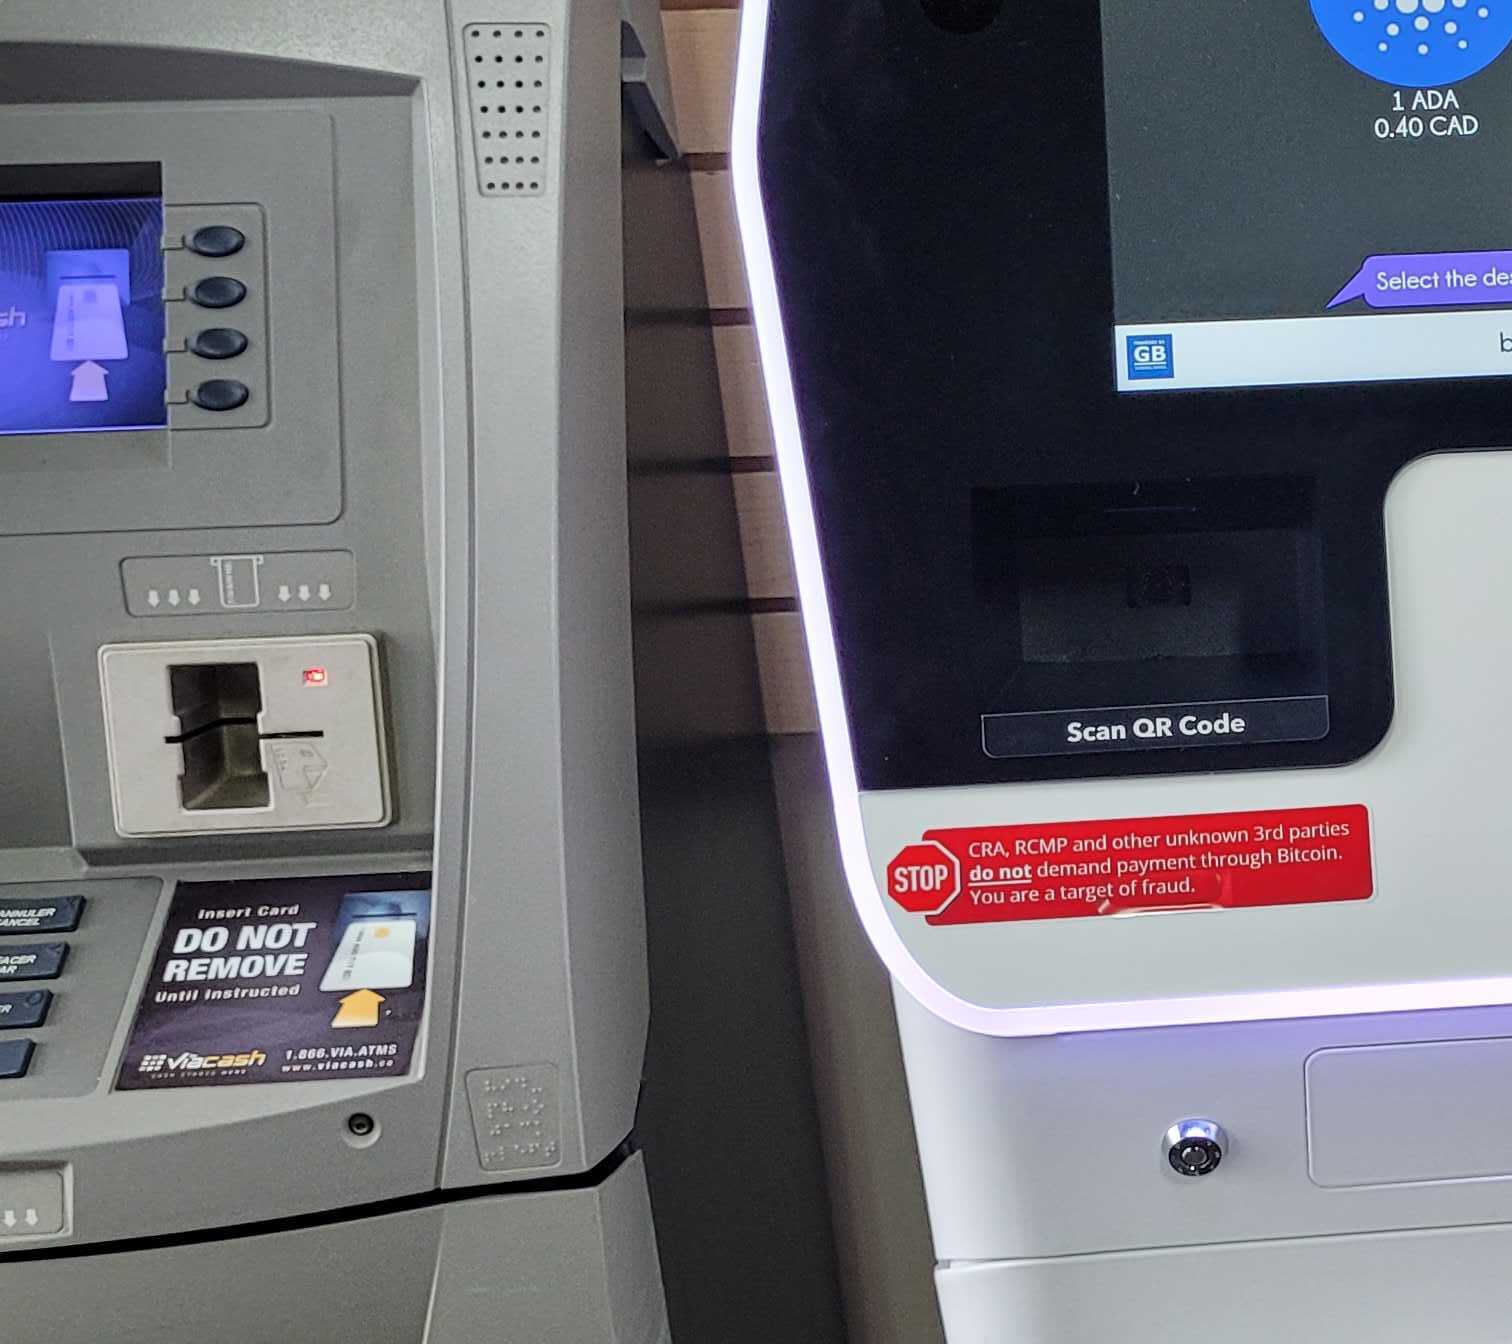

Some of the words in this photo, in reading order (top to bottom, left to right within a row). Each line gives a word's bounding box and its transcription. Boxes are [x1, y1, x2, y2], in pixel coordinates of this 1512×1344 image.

[1393, 91, 1403, 111] 1
[1412, 90, 1459, 110] ADA
[1374, 117, 1423, 138] 0.40
[1430, 116, 1478, 136] CAD
[1376, 270, 1439, 290] Select
[1445, 269, 1478, 288] the
[1134, 346, 1166, 362] GB
[1067, 719, 1126, 743] Scan
[1133, 716, 1172, 740] QR
[1178, 714, 1245, 736] Code
[969, 839, 1010, 859] CRA,
[1015, 836, 1068, 856] RCMP
[1073, 834, 1107, 852] and
[1112, 831, 1156, 850] other
[1161, 827, 1248, 847] unknown
[1254, 825, 1283, 843] 3rd
[1289, 821, 1349, 844] parties
[970, 864, 994, 882] do
[1000, 862, 1032, 881] not
[1037, 858, 1111, 877] demand
[1117, 855, 1196, 879] payment
[1200, 849, 1272, 873] through
[1278, 845, 1342, 864] Bitcoin.
[894, 864, 949, 894] STOP
[970, 886, 1006, 905] You
[1010, 887, 1039, 902] are
[1044, 887, 1054, 899] a
[1059, 880, 1113, 902] target
[1118, 878, 1137, 895] of
[1142, 876, 1195, 895] fraud.
[198, 909, 251, 920] Insert
[258, 905, 300, 917] Card
[172, 927, 230, 953] DO
[236, 922, 318, 949] NOT
[162, 954, 308, 982] REMOVE
[155, 989, 198, 1003] Until
[204, 984, 300, 1000] Instructed
